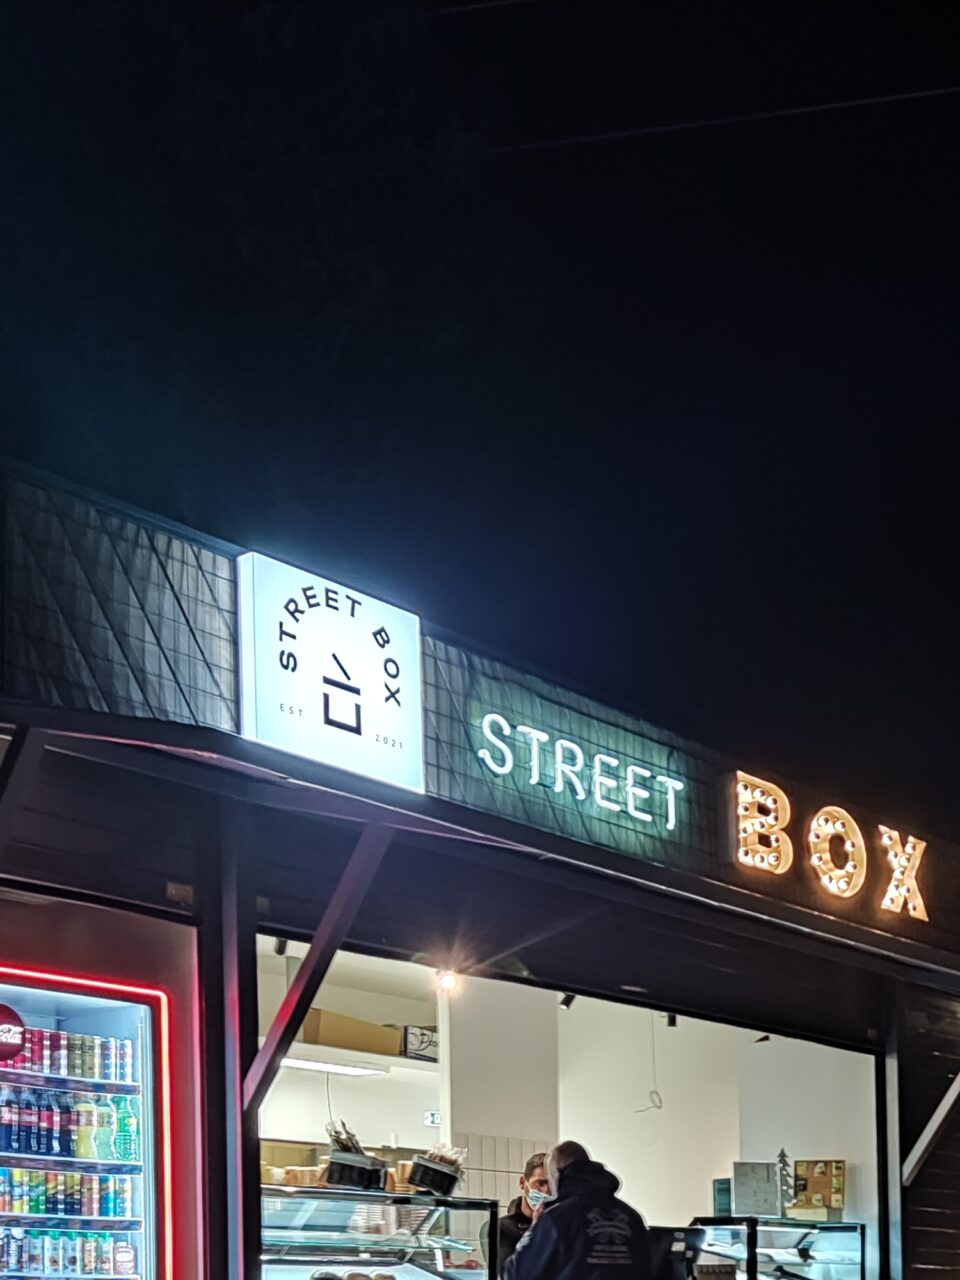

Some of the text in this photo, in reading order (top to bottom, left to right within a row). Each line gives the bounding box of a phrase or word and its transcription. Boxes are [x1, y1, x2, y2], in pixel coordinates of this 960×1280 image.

[279, 585, 402, 708] STREET BOX
[279, 703, 304, 717] EST
[375, 734, 403, 749] 2021
[478, 713, 930, 923] STREET BOX
